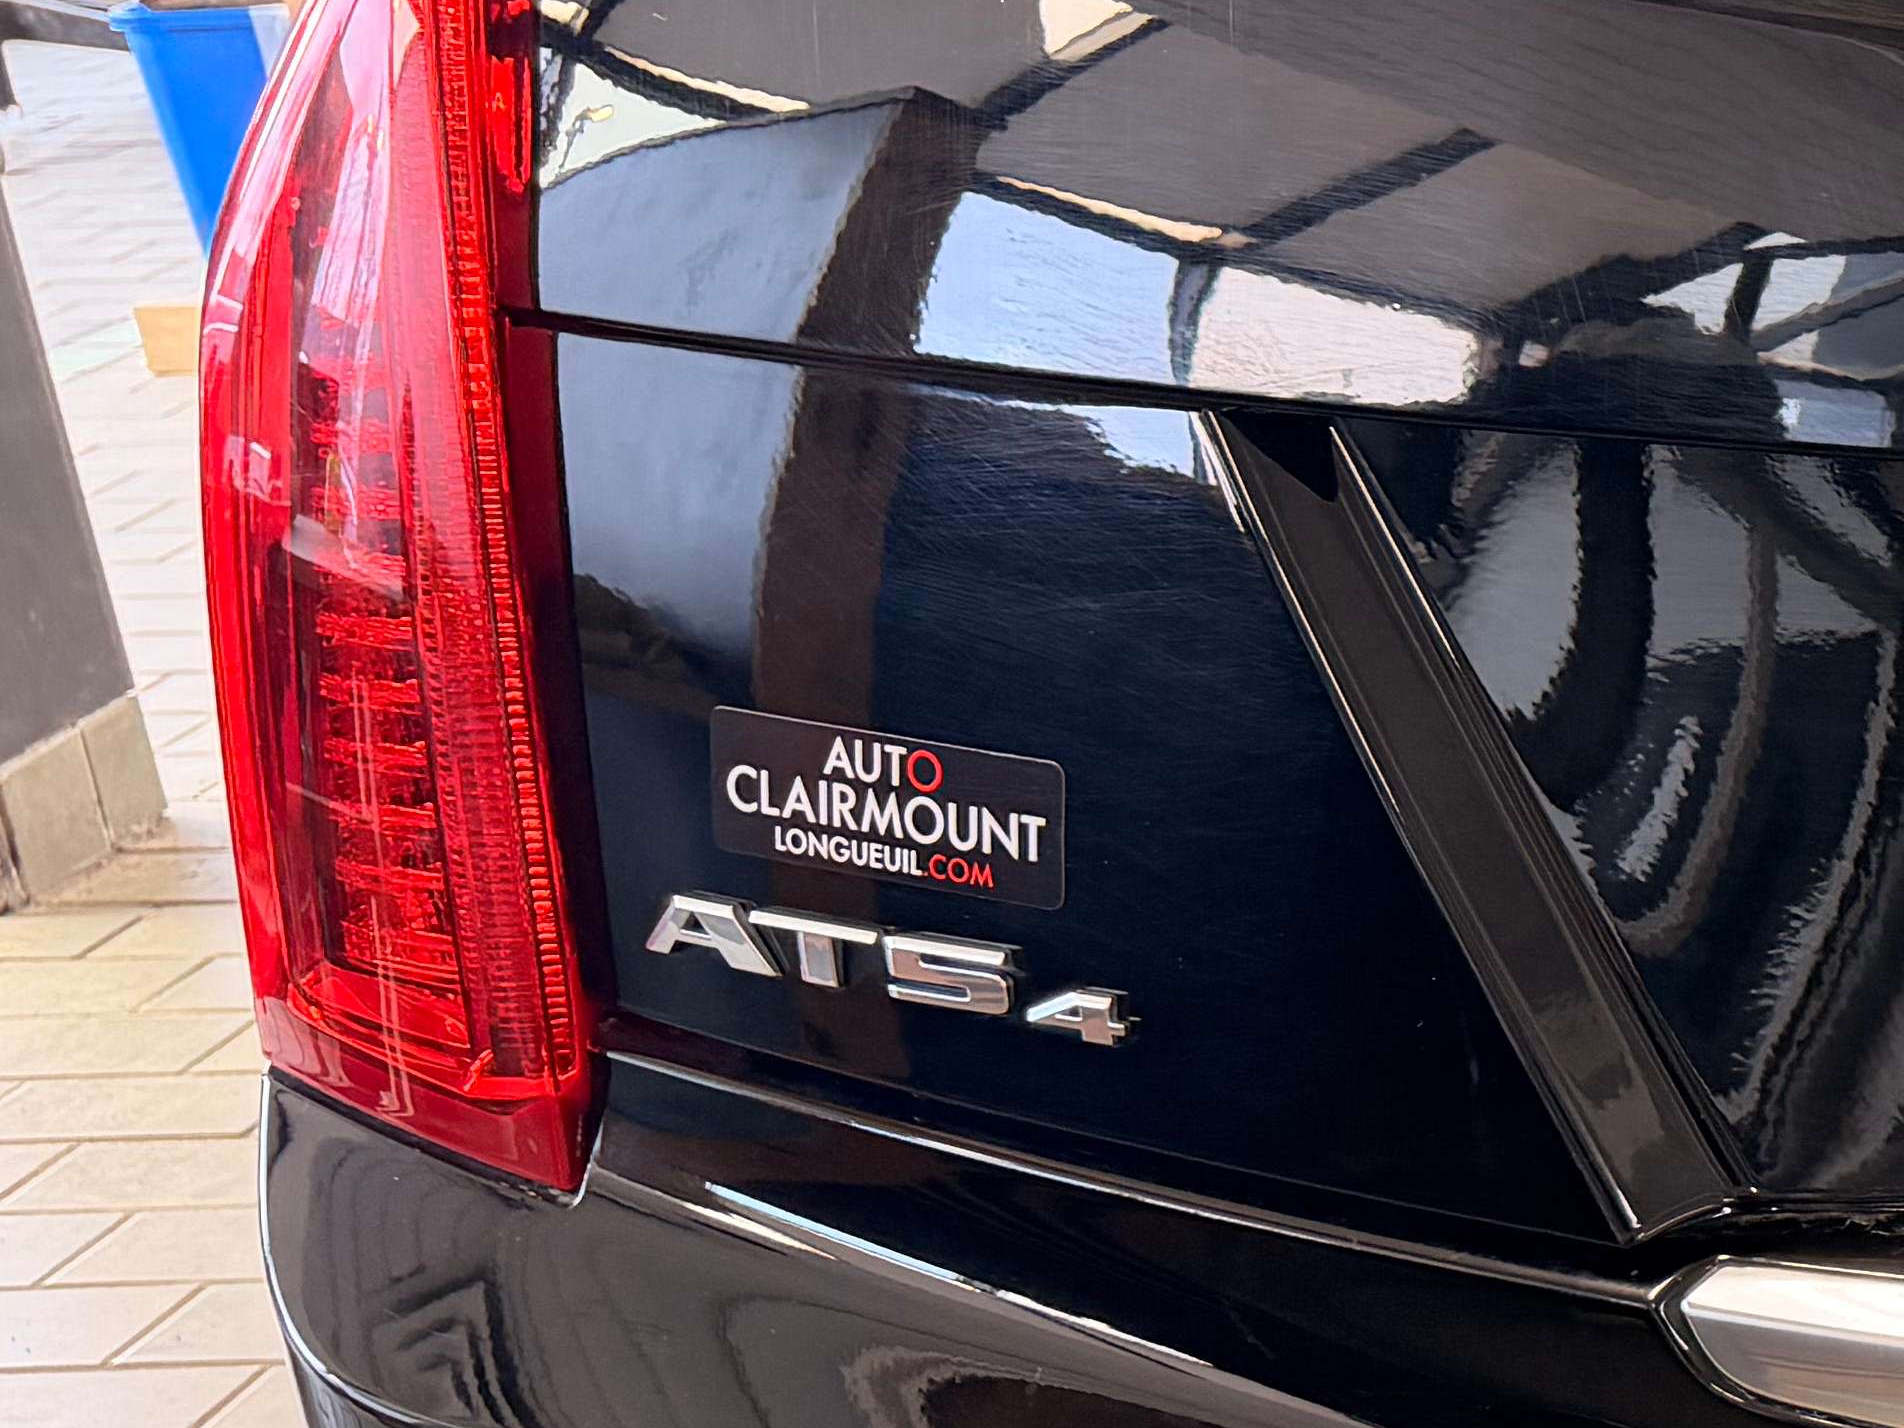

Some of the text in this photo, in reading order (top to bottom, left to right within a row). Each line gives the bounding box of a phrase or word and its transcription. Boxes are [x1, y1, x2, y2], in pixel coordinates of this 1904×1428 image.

[823, 735, 943, 793] AUTO
[726, 765, 1046, 862] CLAIRMOUNT
[774, 825, 994, 888] LONGUEUIL.COM
[645, 893, 1138, 1046] ATS 4
